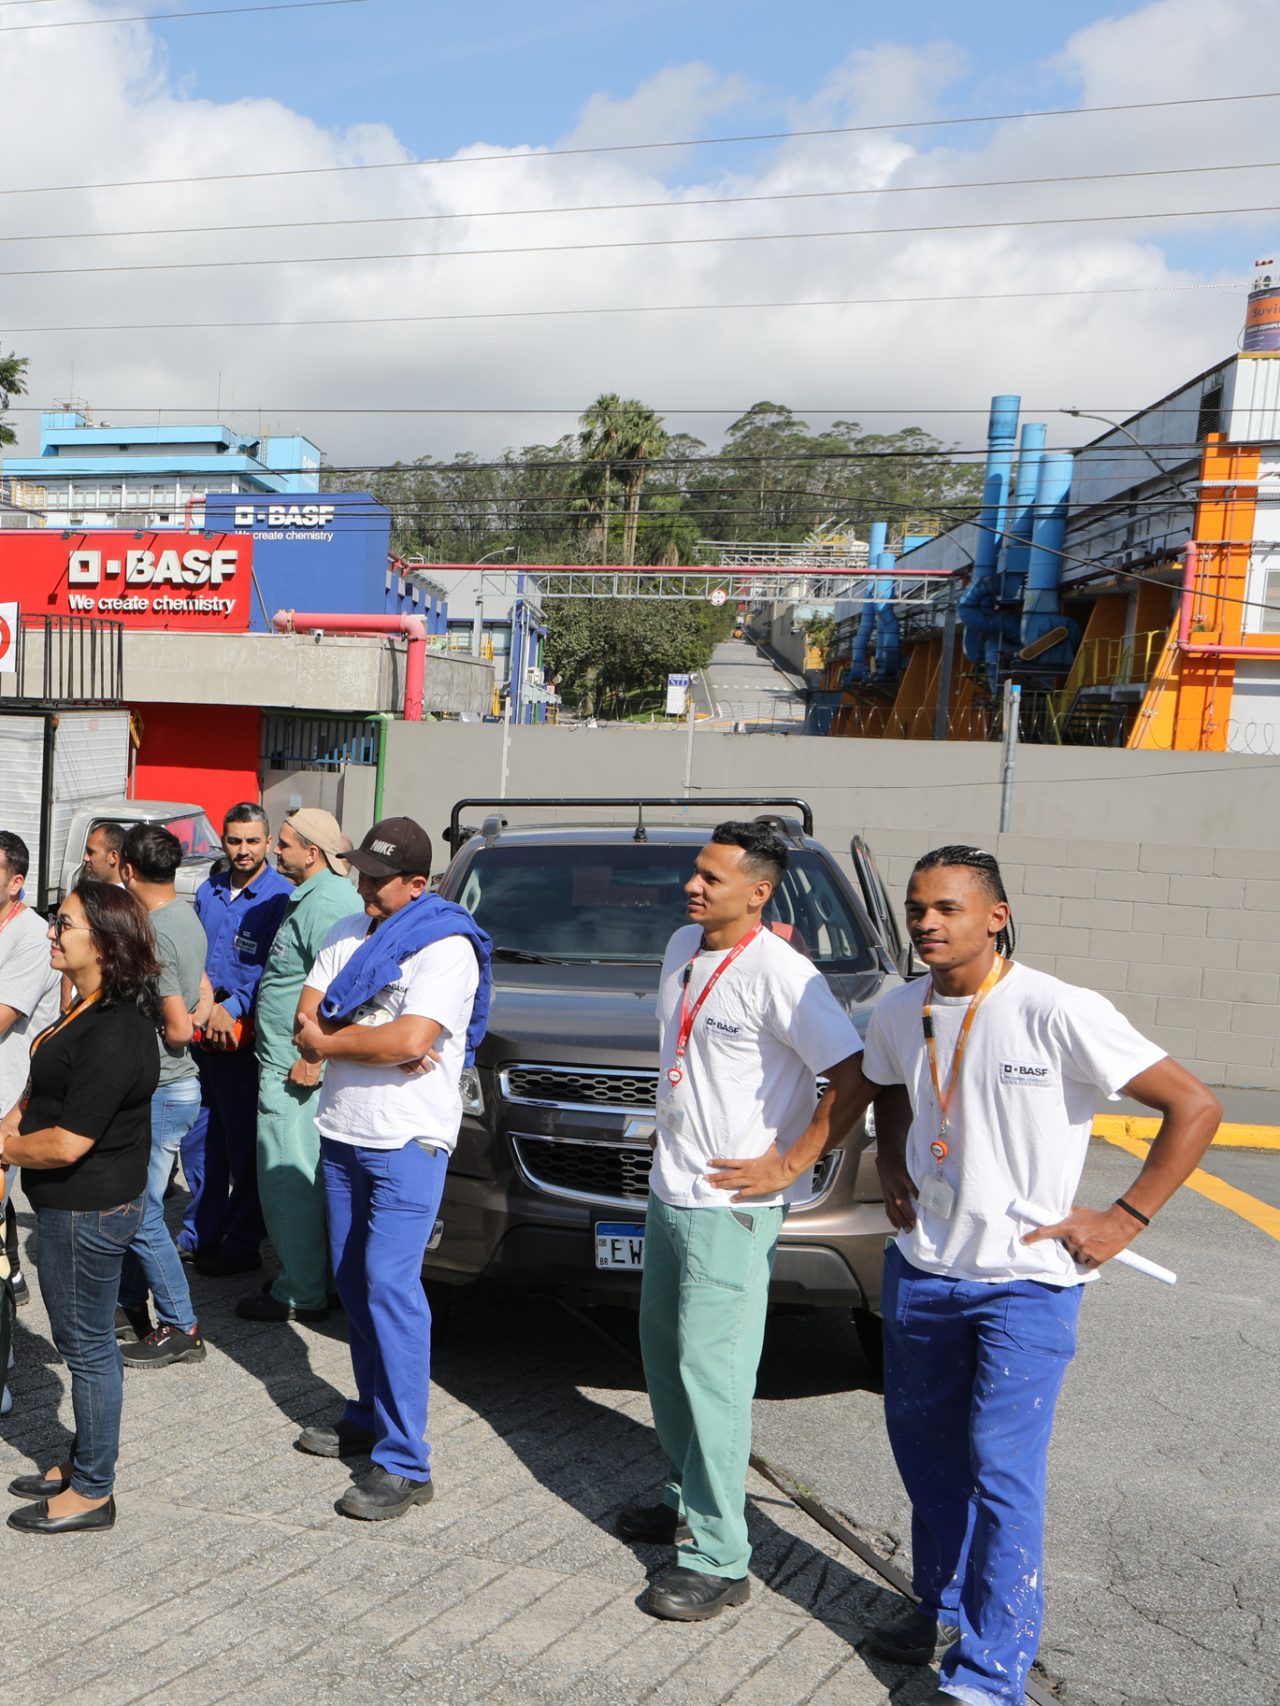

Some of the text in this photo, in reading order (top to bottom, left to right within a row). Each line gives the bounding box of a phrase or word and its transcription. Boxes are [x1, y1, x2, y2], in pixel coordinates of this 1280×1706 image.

[1252, 302, 1280, 319] Suvi
[268, 505, 335, 526] BASF
[253, 531, 283, 540] create
[286, 530, 334, 543] chemistry
[126, 550, 238, 584] BASF
[69, 594, 236, 615] We create chemistry
[370, 839, 397, 856] NIKE
[716, 1021, 740, 1034] BASF
[1019, 1066, 1048, 1077] BASF
[600, 1256, 609, 1266] BR
